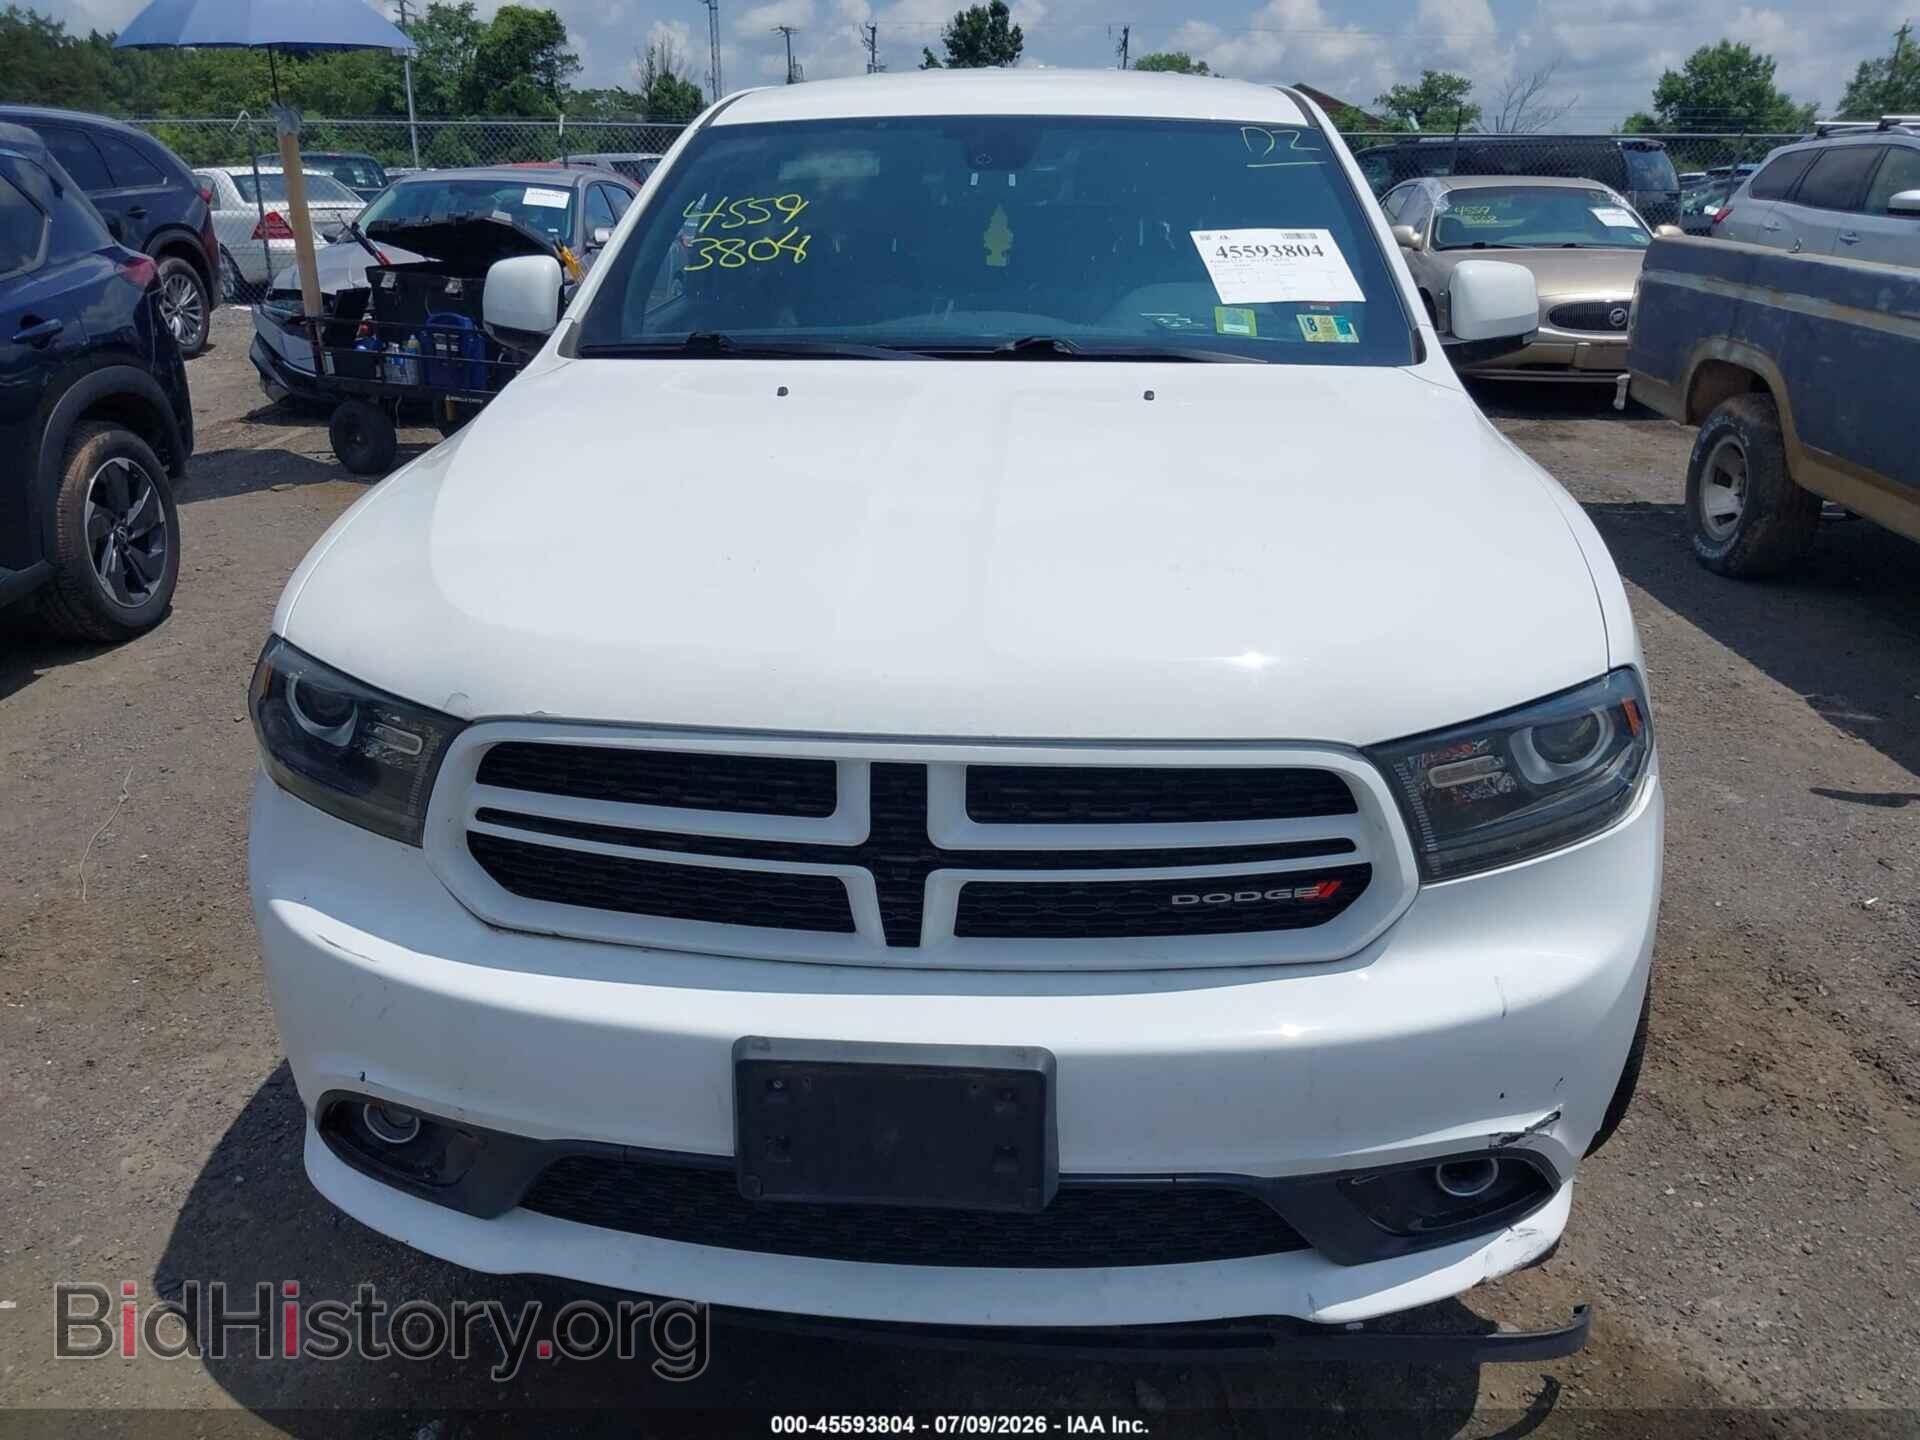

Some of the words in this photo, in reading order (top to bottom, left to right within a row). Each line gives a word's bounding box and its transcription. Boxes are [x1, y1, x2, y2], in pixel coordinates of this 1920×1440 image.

[683, 193, 809, 232] 4559
[684, 226, 812, 271] 3804
[1215, 243, 1325, 259] 45593804
[1172, 886, 1320, 905] DODGE
